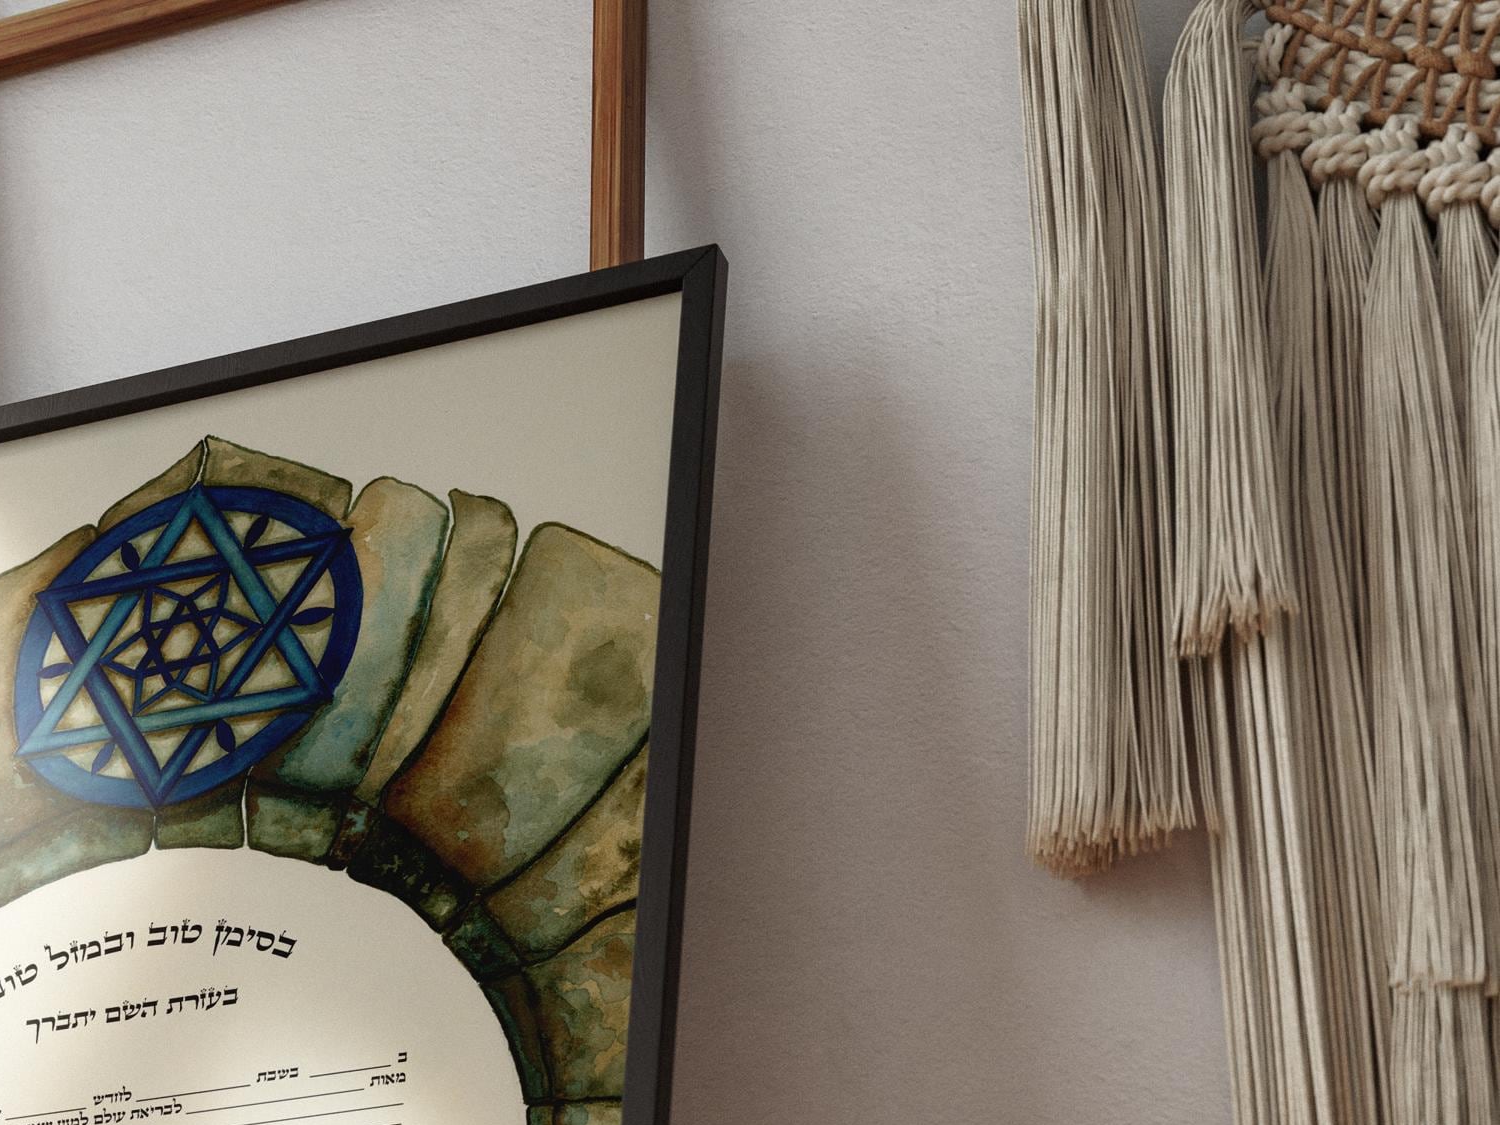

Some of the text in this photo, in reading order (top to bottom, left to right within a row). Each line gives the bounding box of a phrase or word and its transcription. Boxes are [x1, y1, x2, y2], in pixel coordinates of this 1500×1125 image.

[146, 918, 203, 947] טוב
[212, 918, 298, 959] בסימן
[43, 930, 135, 971] ובמזל
[25, 984, 239, 1045] בעזרת השם יתברך
[397, 1051, 408, 1064] ב
[255, 1066, 299, 1084] בשבת
[369, 1071, 407, 1088] מאות
[92, 1085, 133, 1107] לחדש
[93, 1107, 127, 1125] עולם
[129, 1097, 183, 1121] לבריאת
